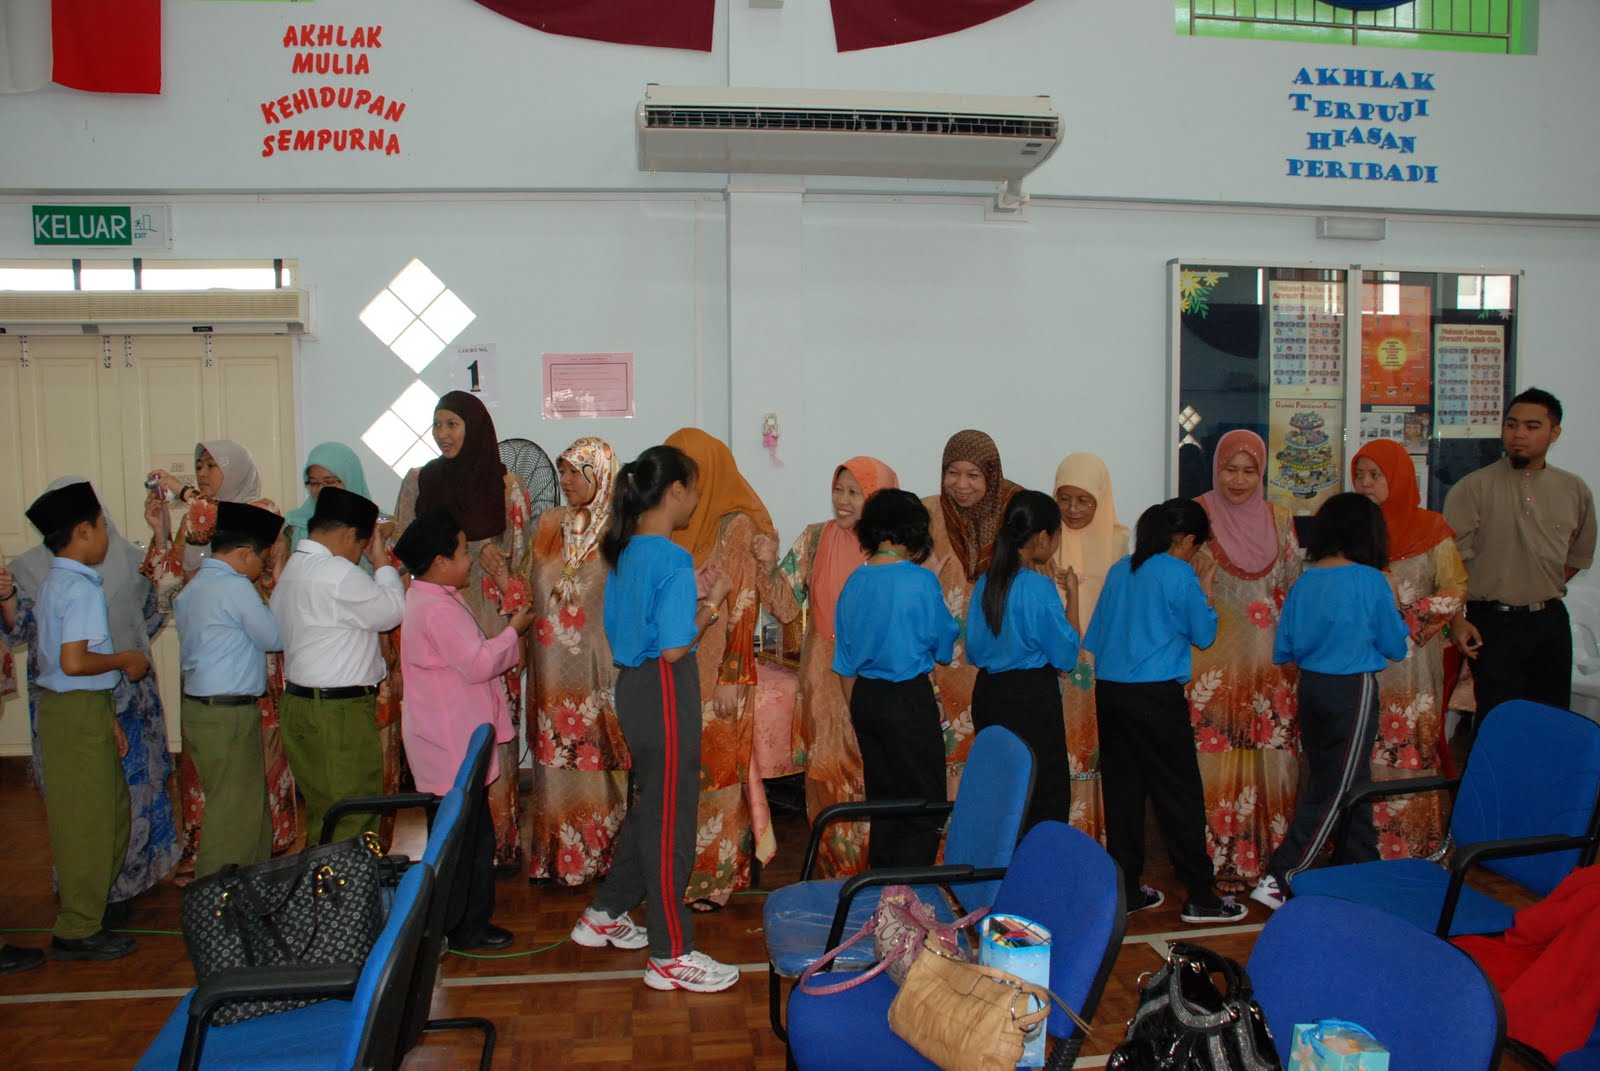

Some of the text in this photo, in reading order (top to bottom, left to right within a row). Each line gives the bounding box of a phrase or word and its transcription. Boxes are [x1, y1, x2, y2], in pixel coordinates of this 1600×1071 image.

[283, 24, 382, 48] AKHLAK
[291, 52, 369, 75] MULIA
[1292, 67, 1436, 91] AKHLAK
[261, 86, 406, 124] KEHIDUPAN
[1288, 92, 1430, 122] TERPUJI
[261, 128, 401, 157] SEMPURNA
[1306, 125, 1416, 154] HIASAN
[1286, 157, 1439, 183] PERIBADI
[34, 214, 127, 239] KELUAR
[467, 360, 481, 392] 1
